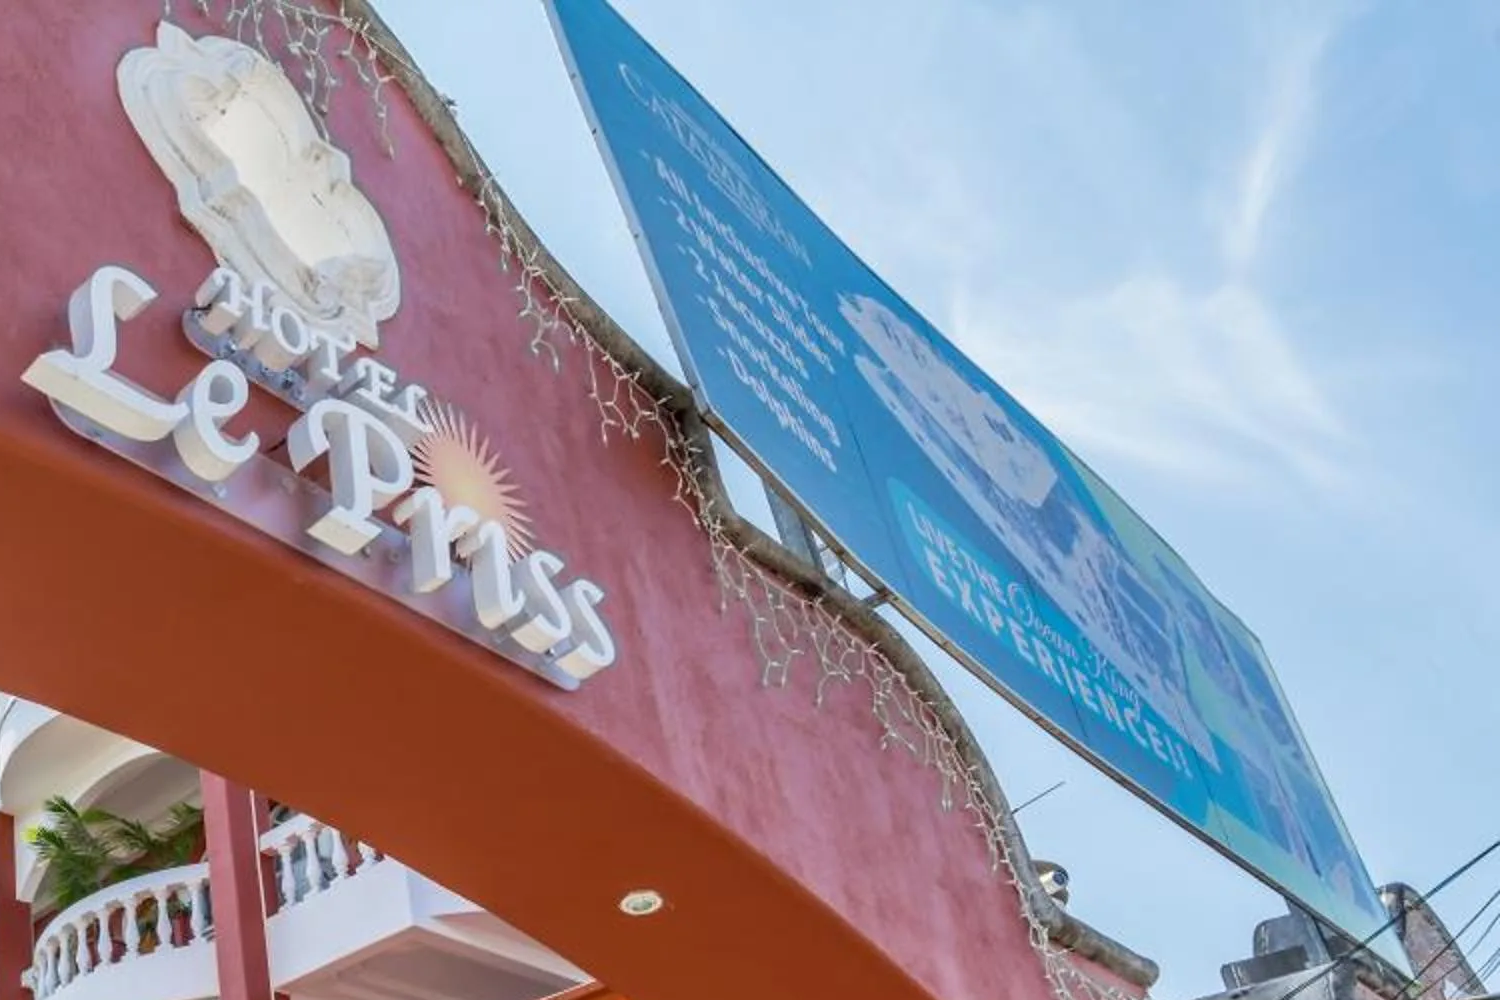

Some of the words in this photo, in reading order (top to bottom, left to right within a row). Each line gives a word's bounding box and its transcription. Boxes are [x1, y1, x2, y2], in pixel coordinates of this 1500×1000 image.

[655, 157, 691, 204] All
[693, 192, 798, 308] Inclusive
[670, 200, 691, 233] 2
[689, 218, 763, 303] Water
[687, 247, 710, 281] 2
[196, 265, 432, 434] HOTEL
[708, 298, 841, 447] Snorkeling
[727, 348, 837, 473] Dolphins
[21, 265, 260, 482] Le
[287, 398, 617, 679] Priss
[906, 502, 962, 568] LIVE
[959, 549, 1008, 606] THE
[1007, 582, 1078, 661] Ocean
